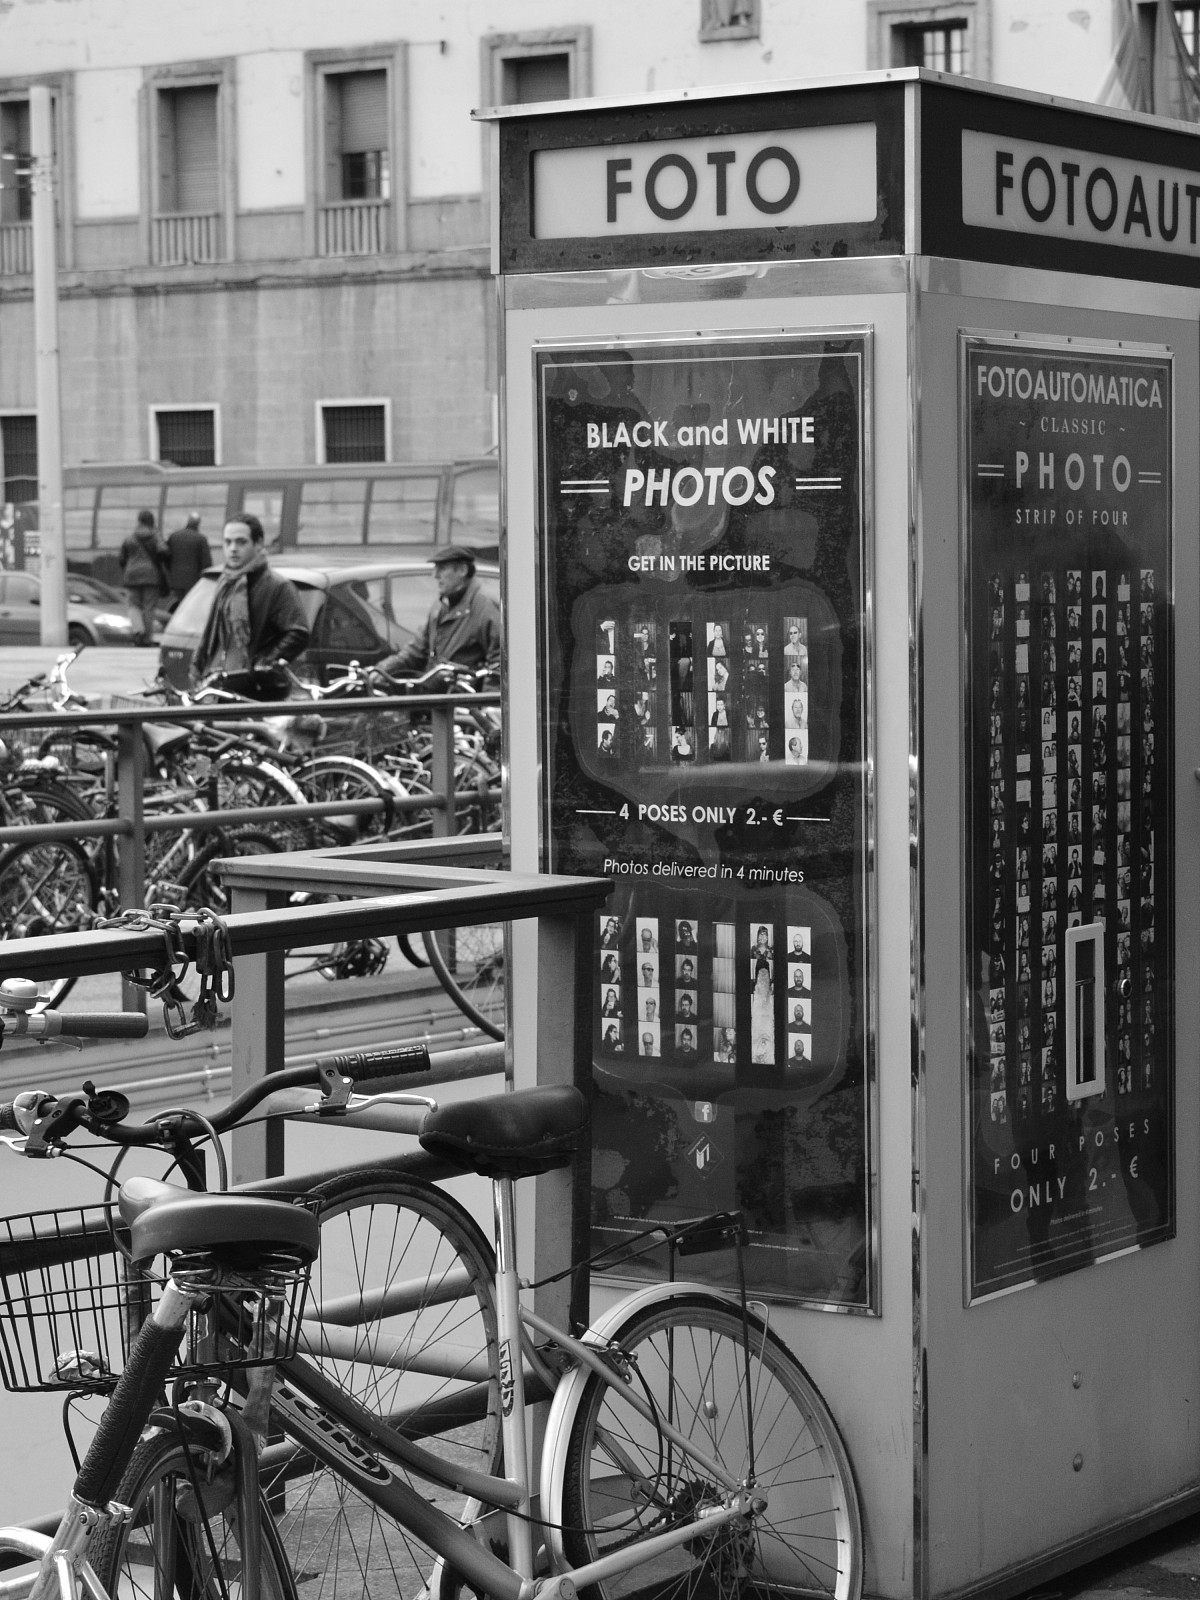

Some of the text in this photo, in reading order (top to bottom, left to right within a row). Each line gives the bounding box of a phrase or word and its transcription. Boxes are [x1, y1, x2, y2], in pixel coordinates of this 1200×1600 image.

[606, 146, 800, 223] FOTO
[977, 365, 1163, 409] FOTOAUTOMATICA
[586, 416, 815, 449] BLACK and WHITE
[1040, 416, 1107, 435] CLASSIC
[623, 465, 777, 507] PHOTOS
[1015, 451, 1132, 493] PHOTO
[1015, 508, 1128, 526] STRIP OF FOUR
[627, 555, 770, 572] GET IN THE PICTURE
[619, 803, 630, 820] 4
[638, 803, 687, 823] POSES
[692, 806, 737, 824] ONLY
[772, 809, 784, 826] €
[603, 858, 805, 883] Photos delivered in 4 minutes
[994, 1118, 1150, 1175] FOUR POSES
[1010, 1175, 1067, 1213] ONLY
[1129, 1155, 1139, 1179] €
